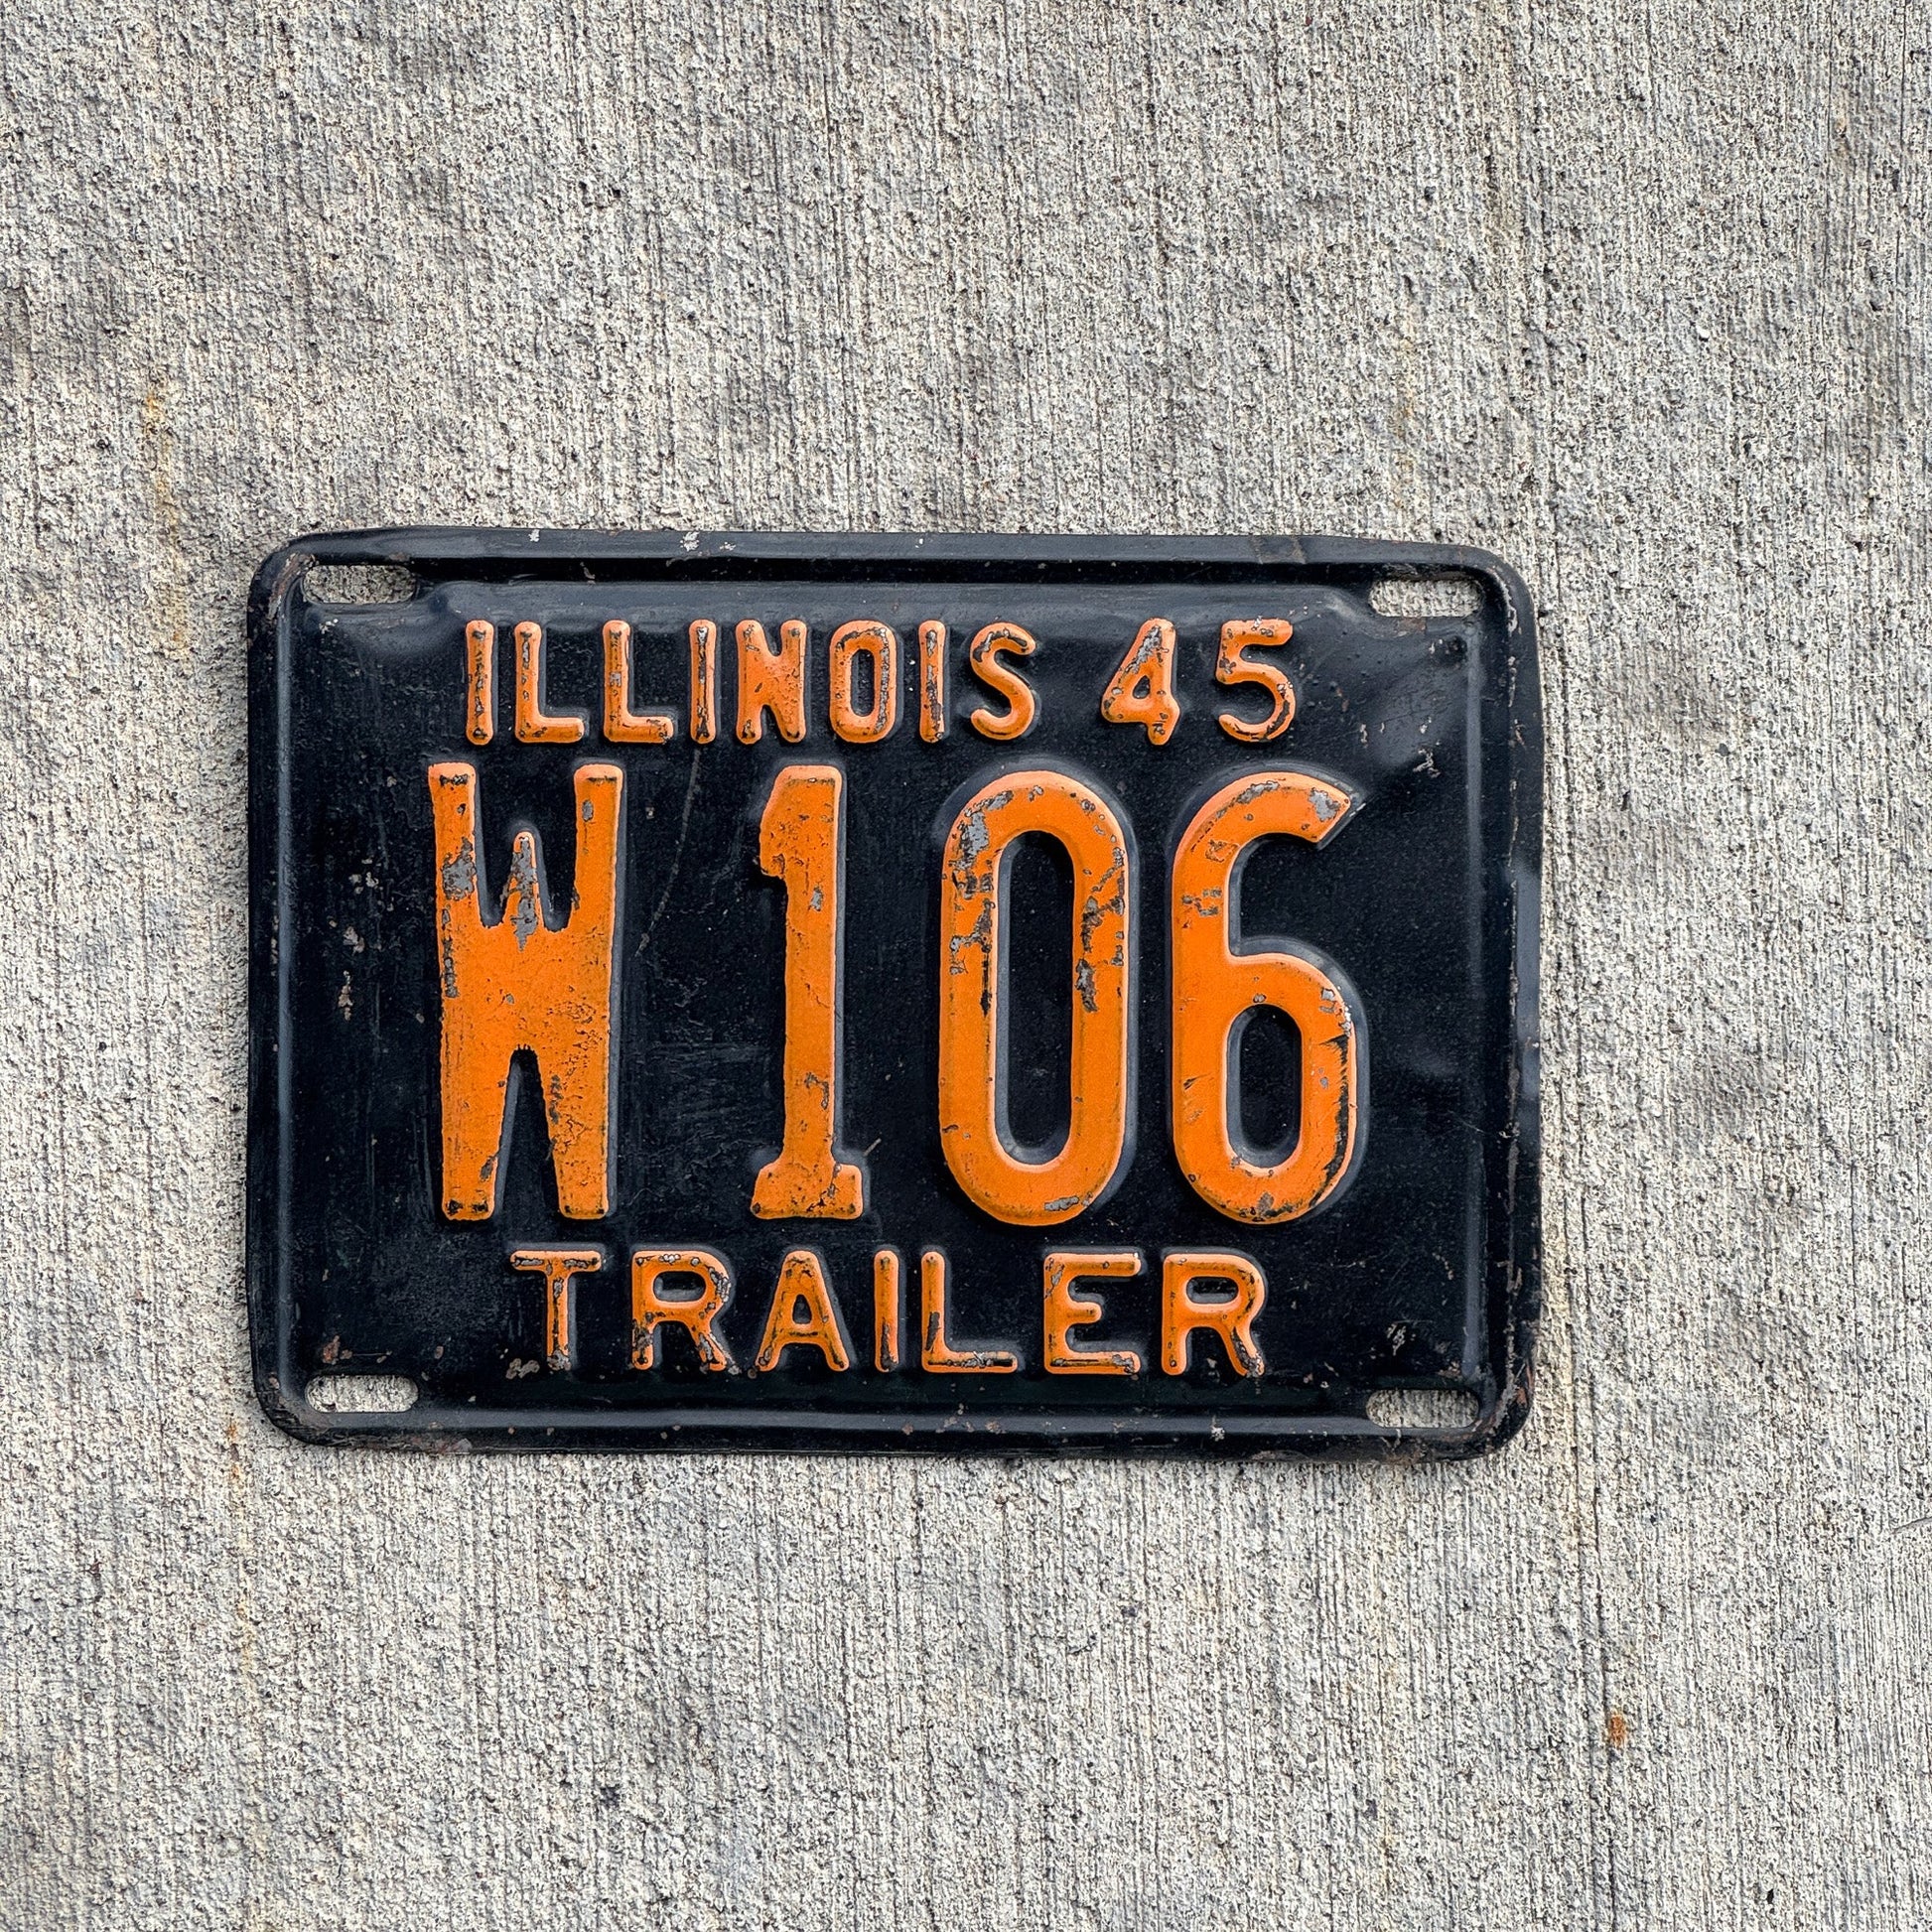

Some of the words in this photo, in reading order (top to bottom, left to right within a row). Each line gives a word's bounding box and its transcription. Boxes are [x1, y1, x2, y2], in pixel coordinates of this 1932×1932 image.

[465, 620, 1038, 746] ILLINOIS
[1101, 618, 1298, 746] 45
[510, 1249, 1267, 1377] TRAILER
